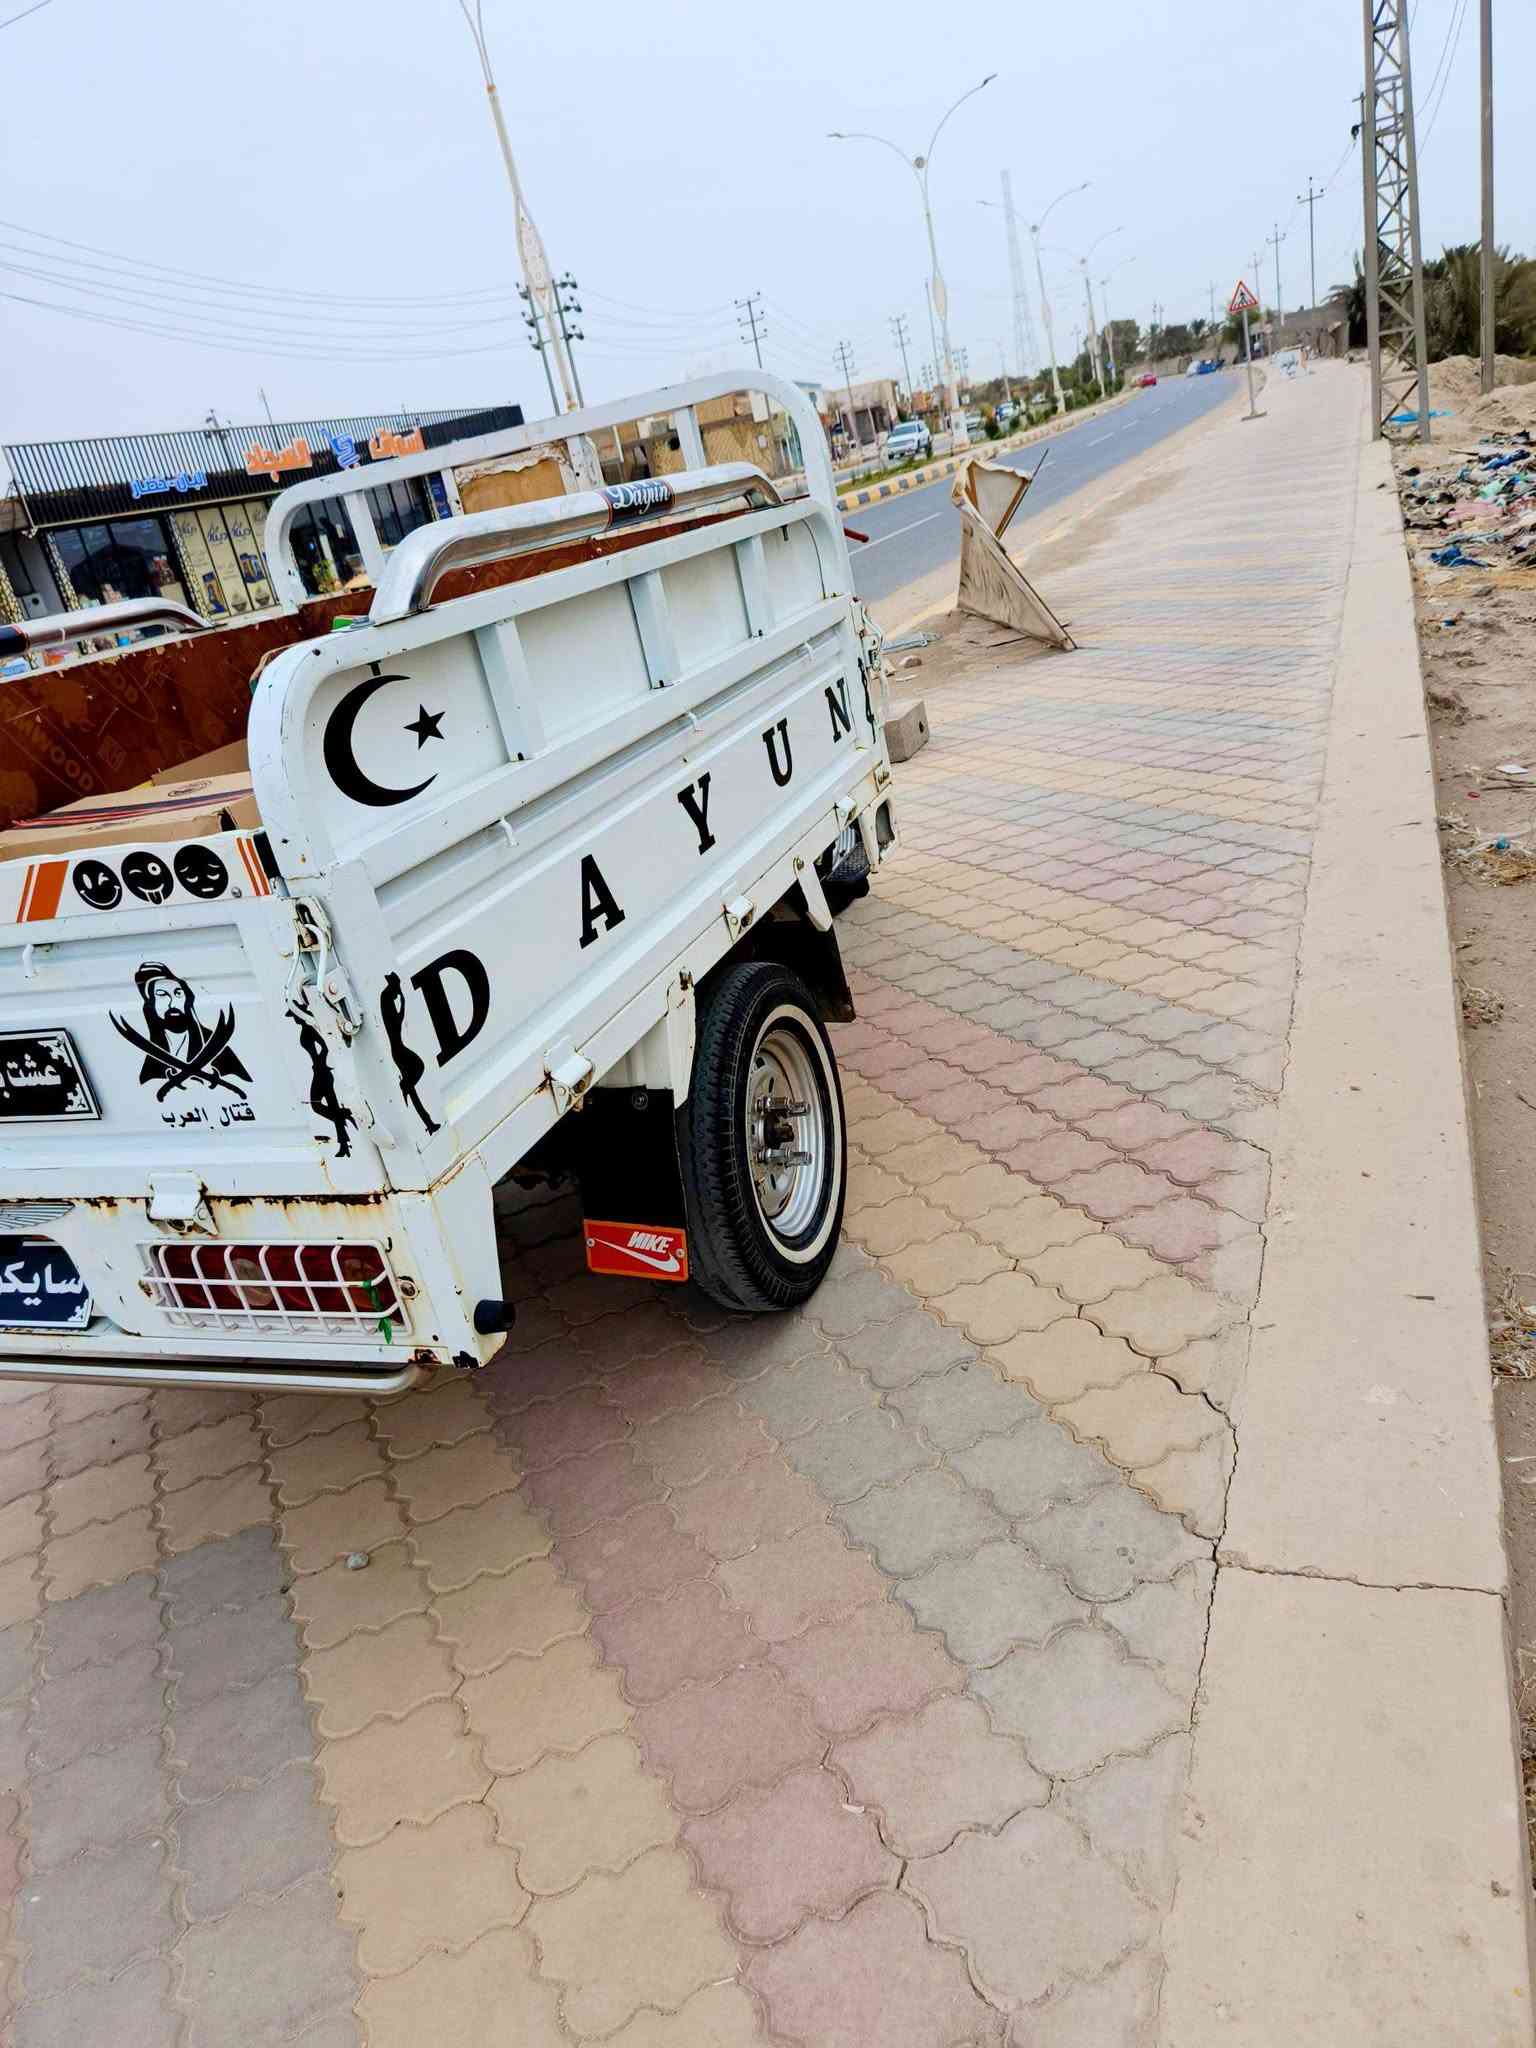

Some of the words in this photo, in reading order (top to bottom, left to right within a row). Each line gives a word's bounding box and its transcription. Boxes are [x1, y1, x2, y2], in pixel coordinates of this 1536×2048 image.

[411, 678, 853, 1067] DAYUN
[220, 1102, 256, 1127] قتال
[627, 1231, 674, 1254] NIKE
